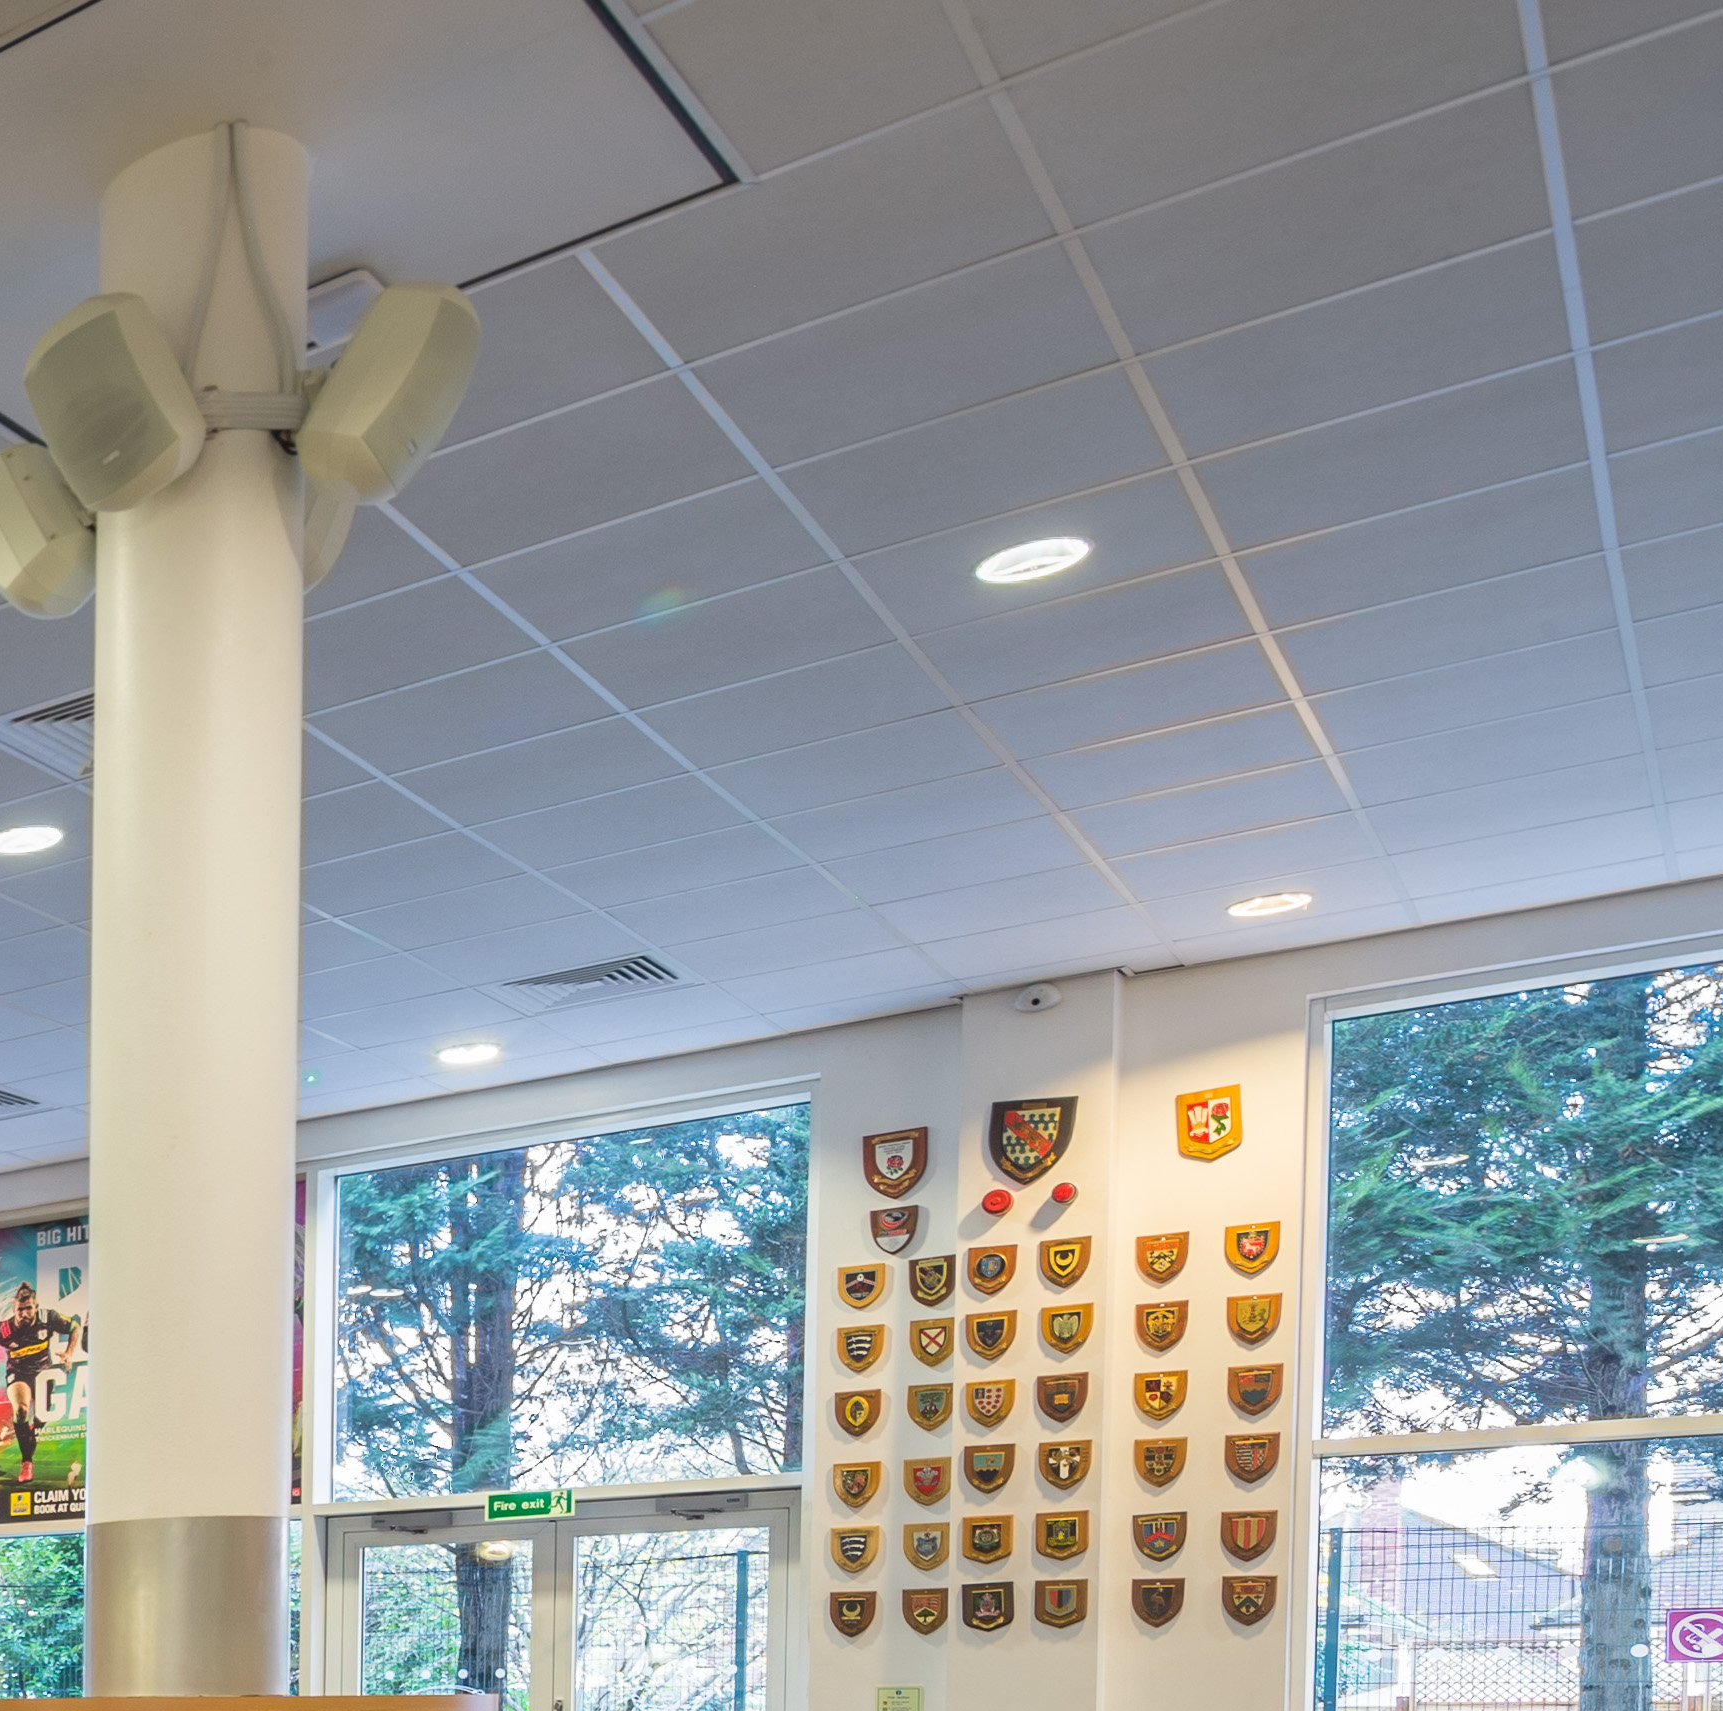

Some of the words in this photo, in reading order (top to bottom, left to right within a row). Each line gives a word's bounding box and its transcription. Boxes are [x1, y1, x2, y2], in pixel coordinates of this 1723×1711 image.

[37, 1229, 61, 1247] BIG
[34, 1423, 86, 1435] HARLEQUINS
[34, 1489, 69, 1504] CLAIM
[33, 1503, 57, 1515] BOOK
[57, 1503, 69, 1513] AT
[493, 1501, 517, 1511] Fire
[521, 1498, 545, 1509] exit
